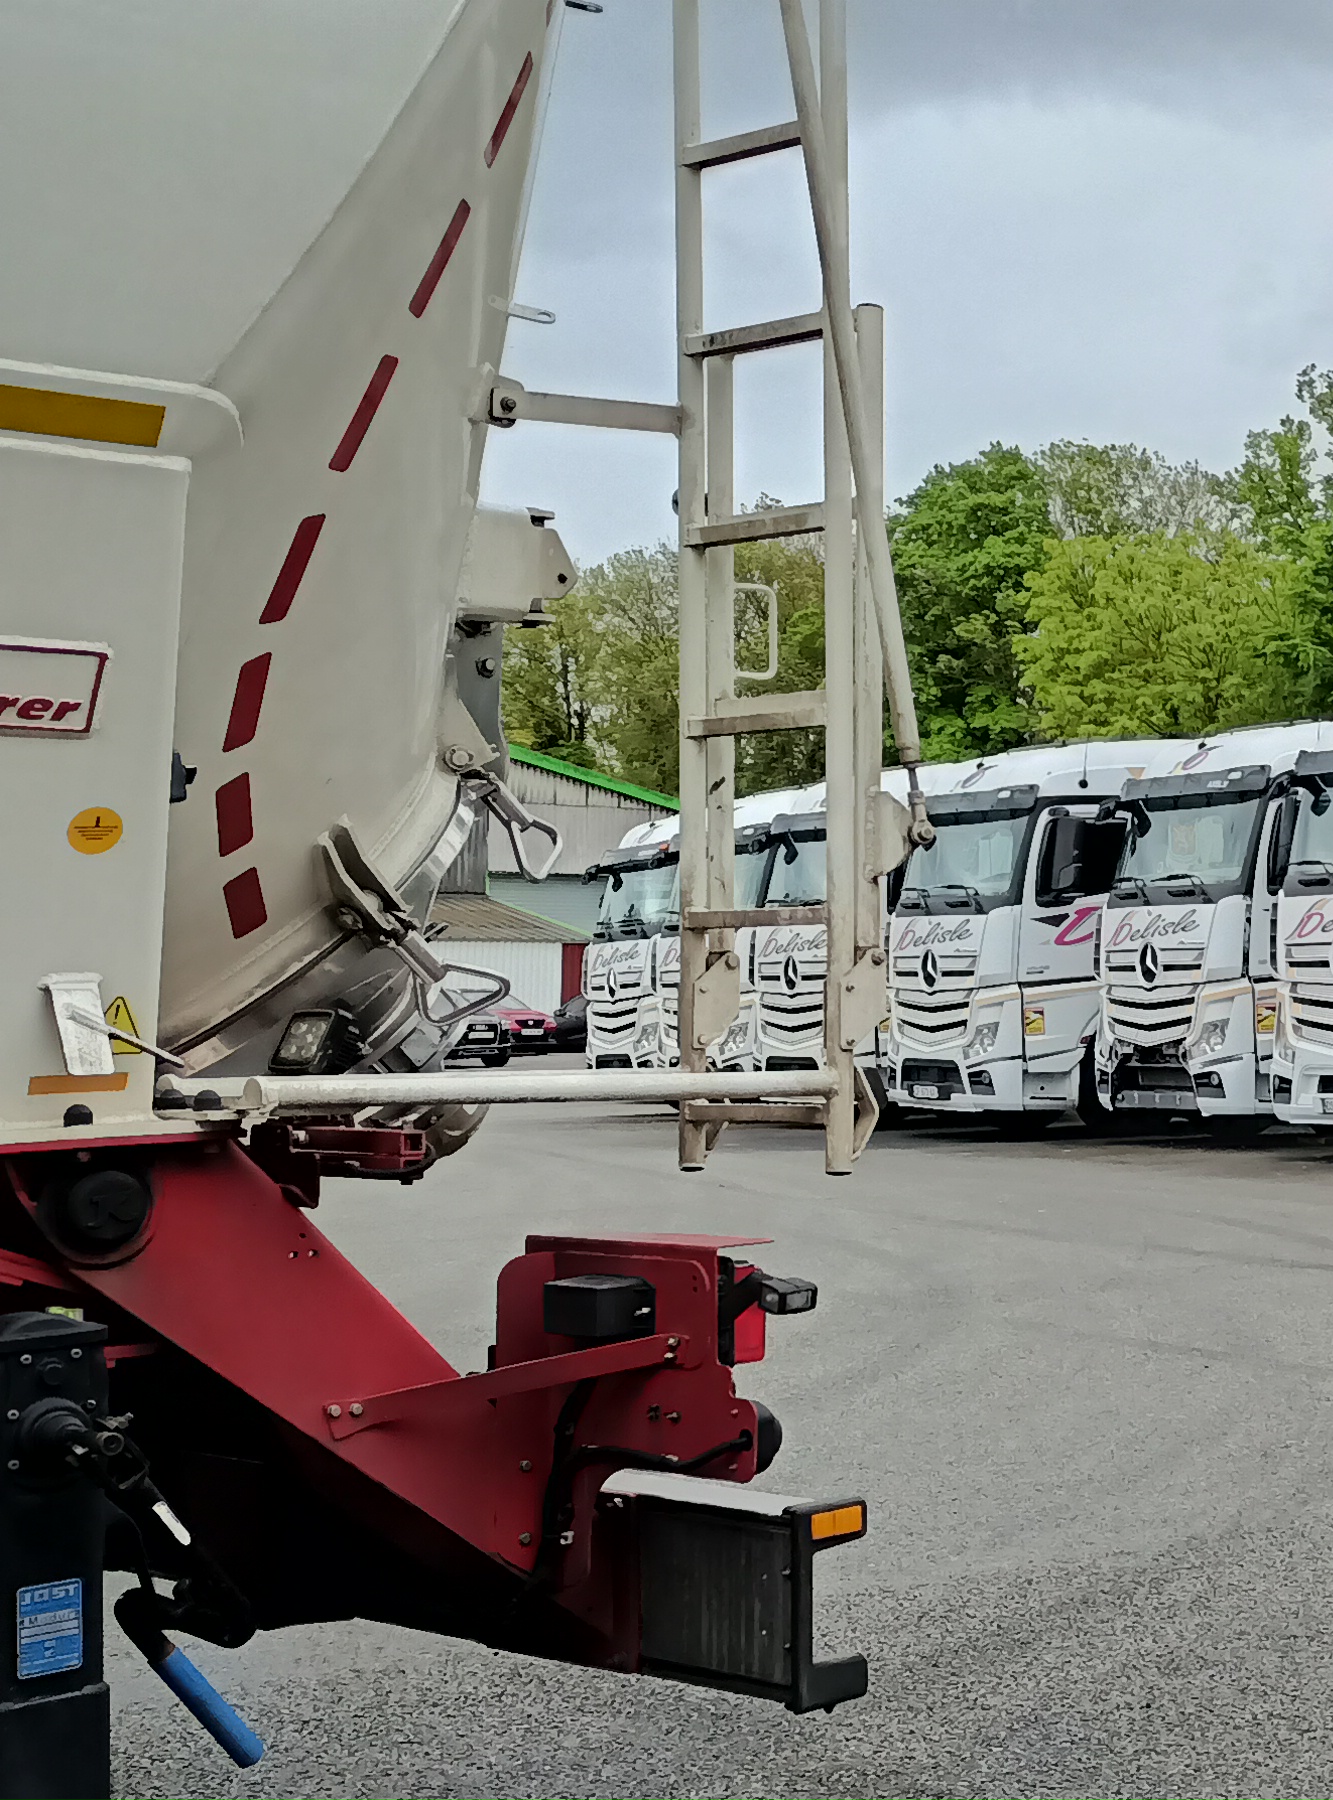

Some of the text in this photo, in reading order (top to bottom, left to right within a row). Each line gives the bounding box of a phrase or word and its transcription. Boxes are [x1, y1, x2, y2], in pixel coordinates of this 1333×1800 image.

[898, 917, 974, 951] Delisle
[1112, 908, 1200, 947] Delisle
[20, 1583, 79, 1606] JOST
